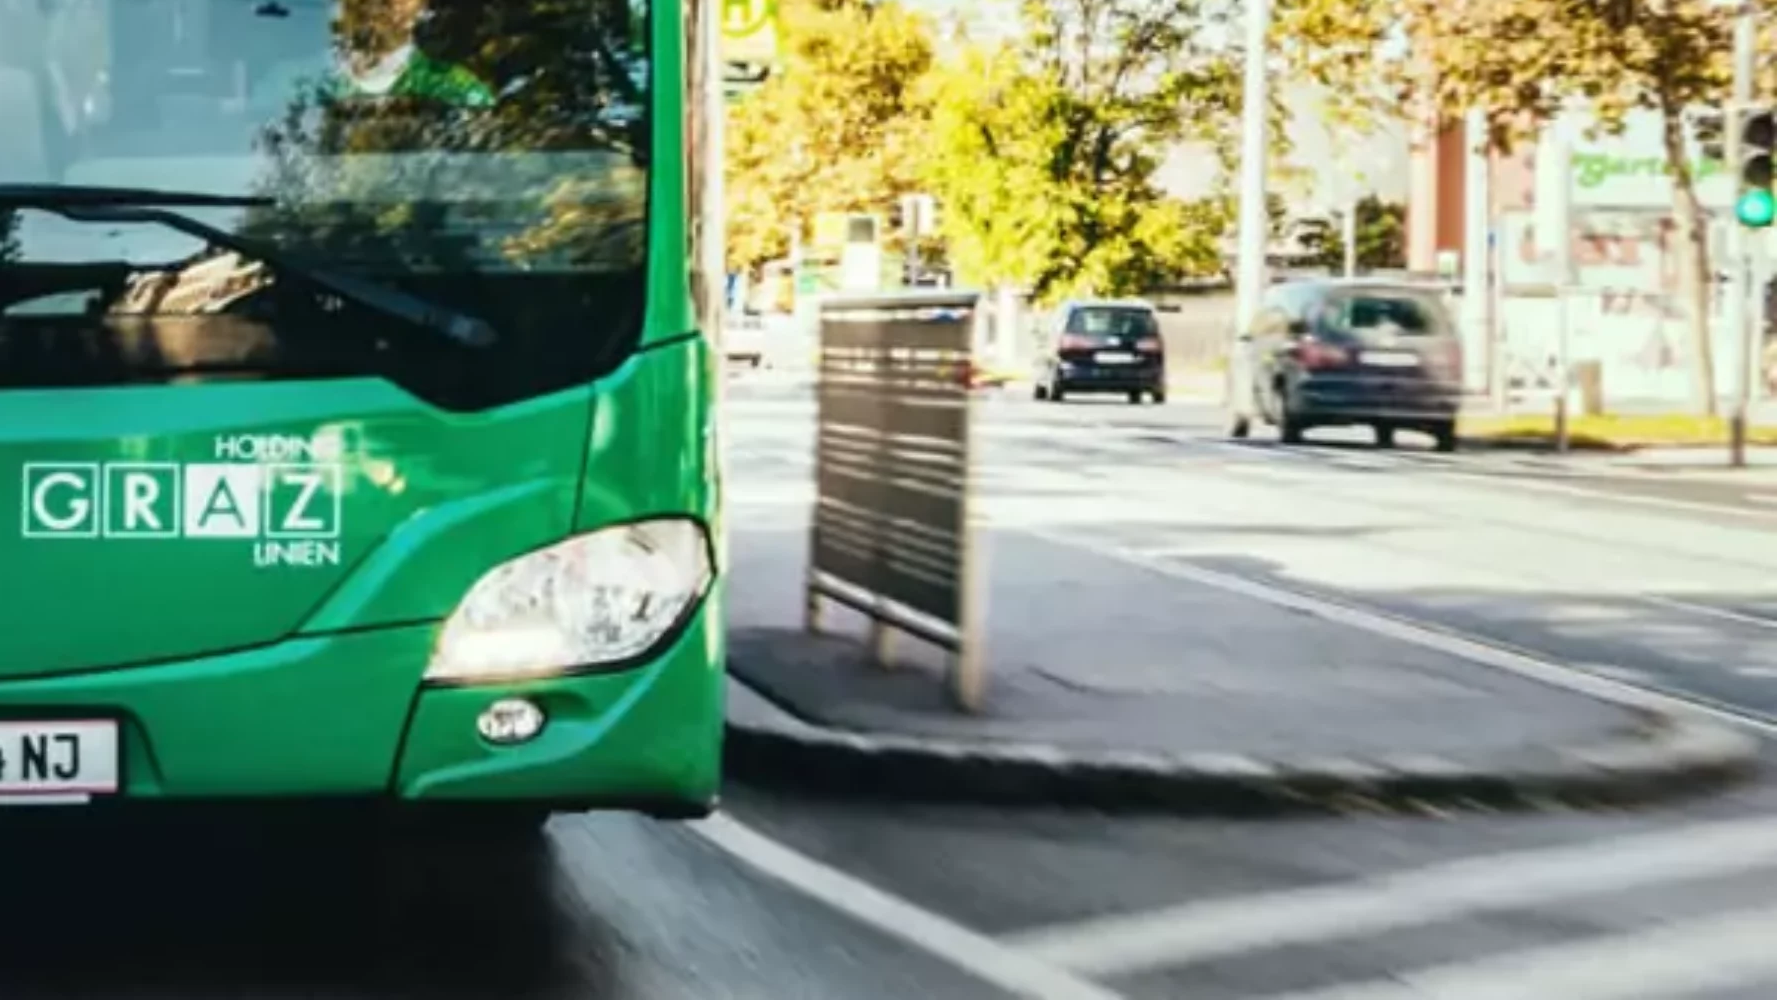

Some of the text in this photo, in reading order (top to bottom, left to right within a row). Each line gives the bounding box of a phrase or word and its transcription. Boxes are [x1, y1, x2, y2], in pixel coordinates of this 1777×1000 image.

[30, 470, 326, 531] GRAZ
[253, 542, 340, 565] LINIEN
[21, 733, 80, 781] NJ
